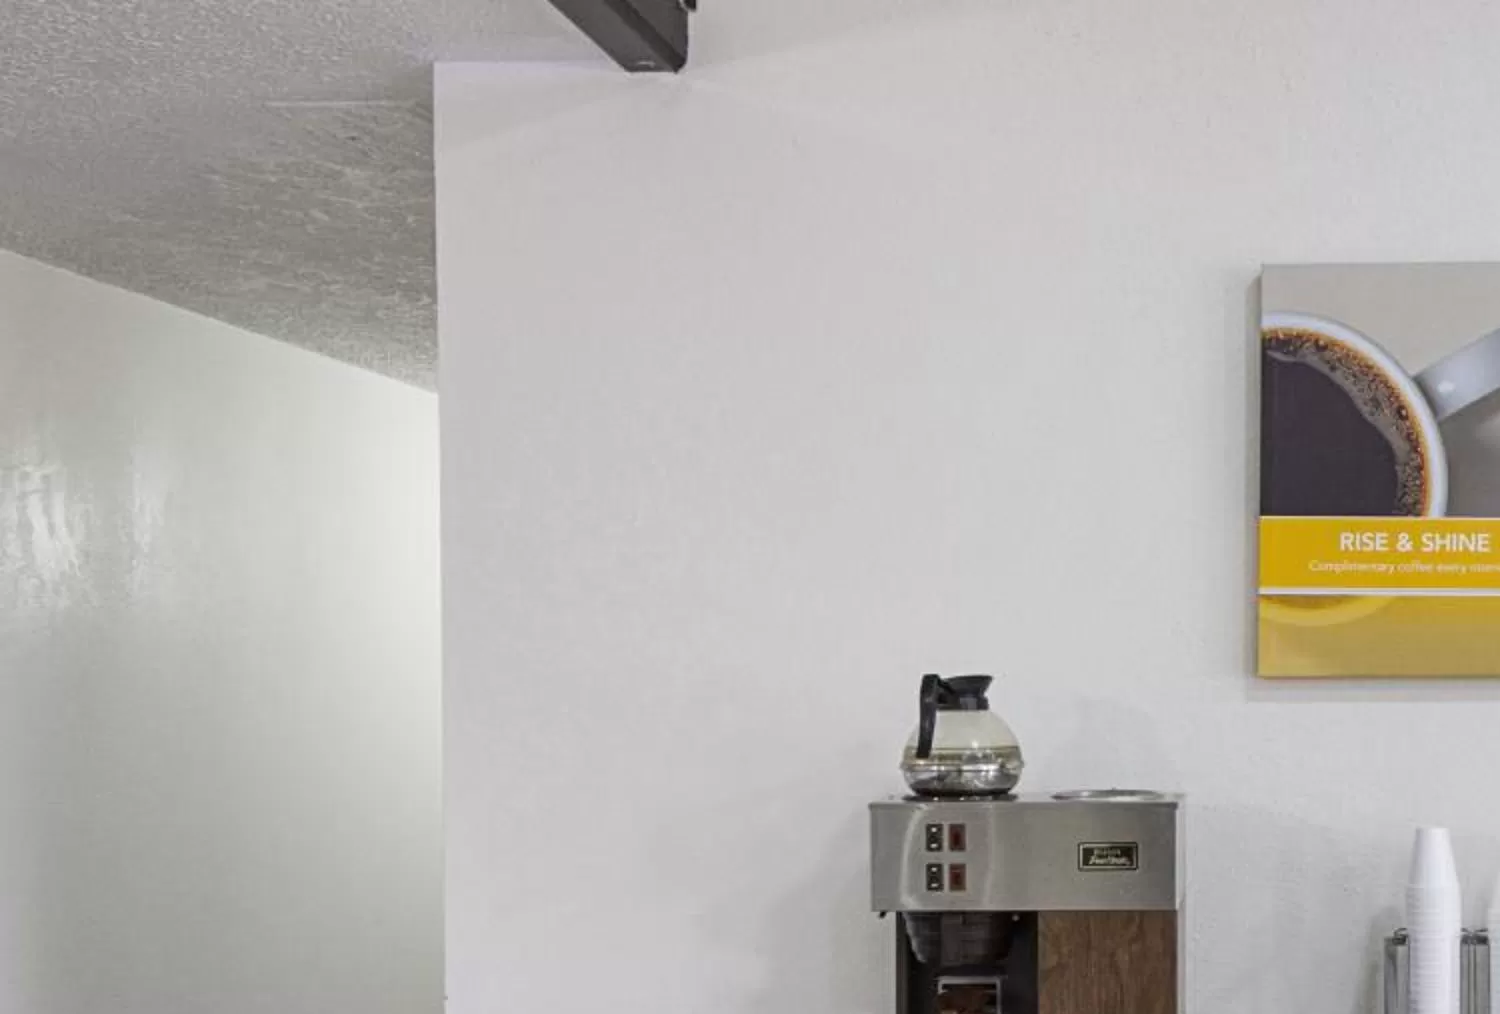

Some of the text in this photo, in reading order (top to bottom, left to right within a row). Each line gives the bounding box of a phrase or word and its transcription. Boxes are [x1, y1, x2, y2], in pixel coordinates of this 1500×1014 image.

[1340, 531, 1490, 552] RISE & SHINE
[1308, 559, 1395, 575] Complimentary
[1397, 560, 1434, 573] coffee
[1436, 563, 1467, 576] every
